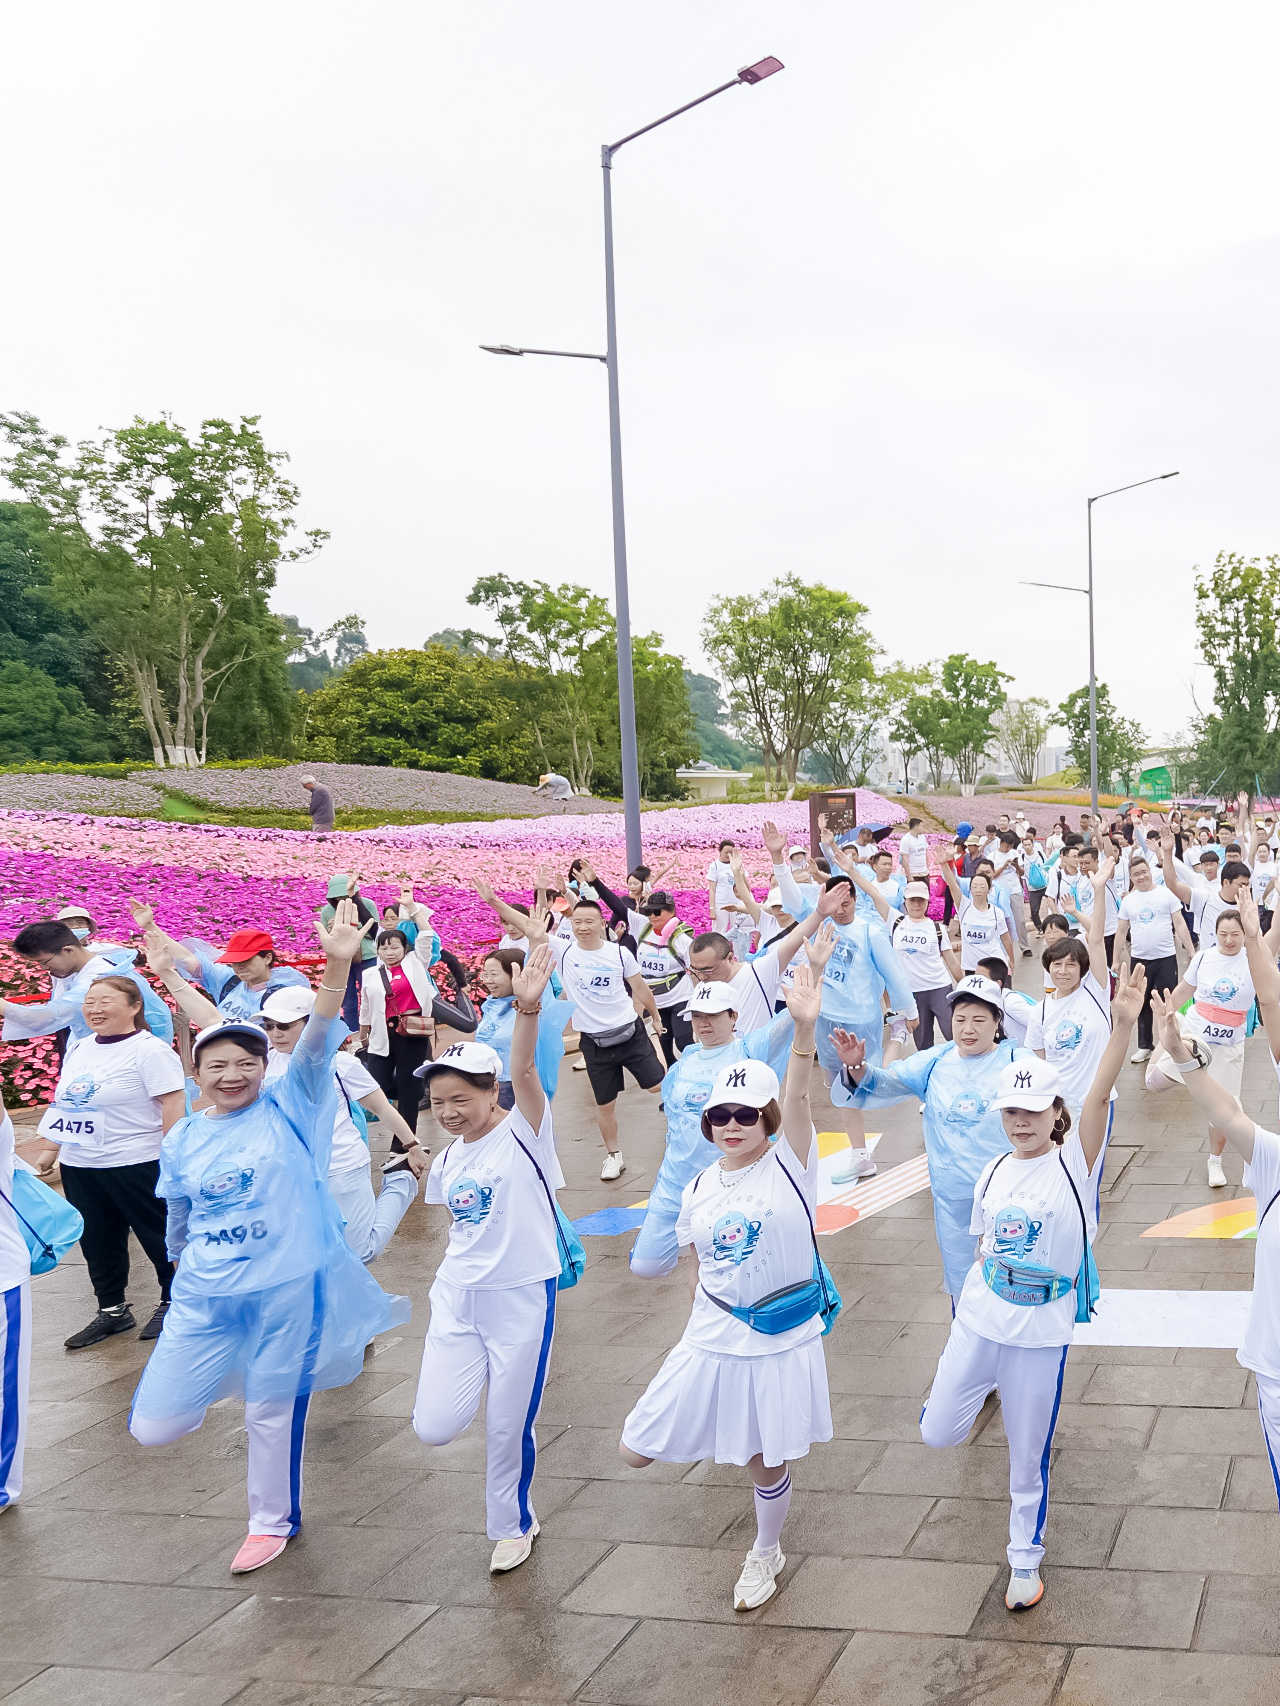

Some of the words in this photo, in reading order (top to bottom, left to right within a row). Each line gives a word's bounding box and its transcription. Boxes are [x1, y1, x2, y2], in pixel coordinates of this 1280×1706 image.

[901, 935, 927, 945] A370
[966, 930, 986, 940] A451
[641, 960, 664, 972] A433
[590, 976, 610, 987] 25
[825, 968, 846, 983] 321
[1203, 1025, 1233, 1039] A320
[49, 1118, 95, 1134] A475
[204, 1220, 267, 1246] A498
